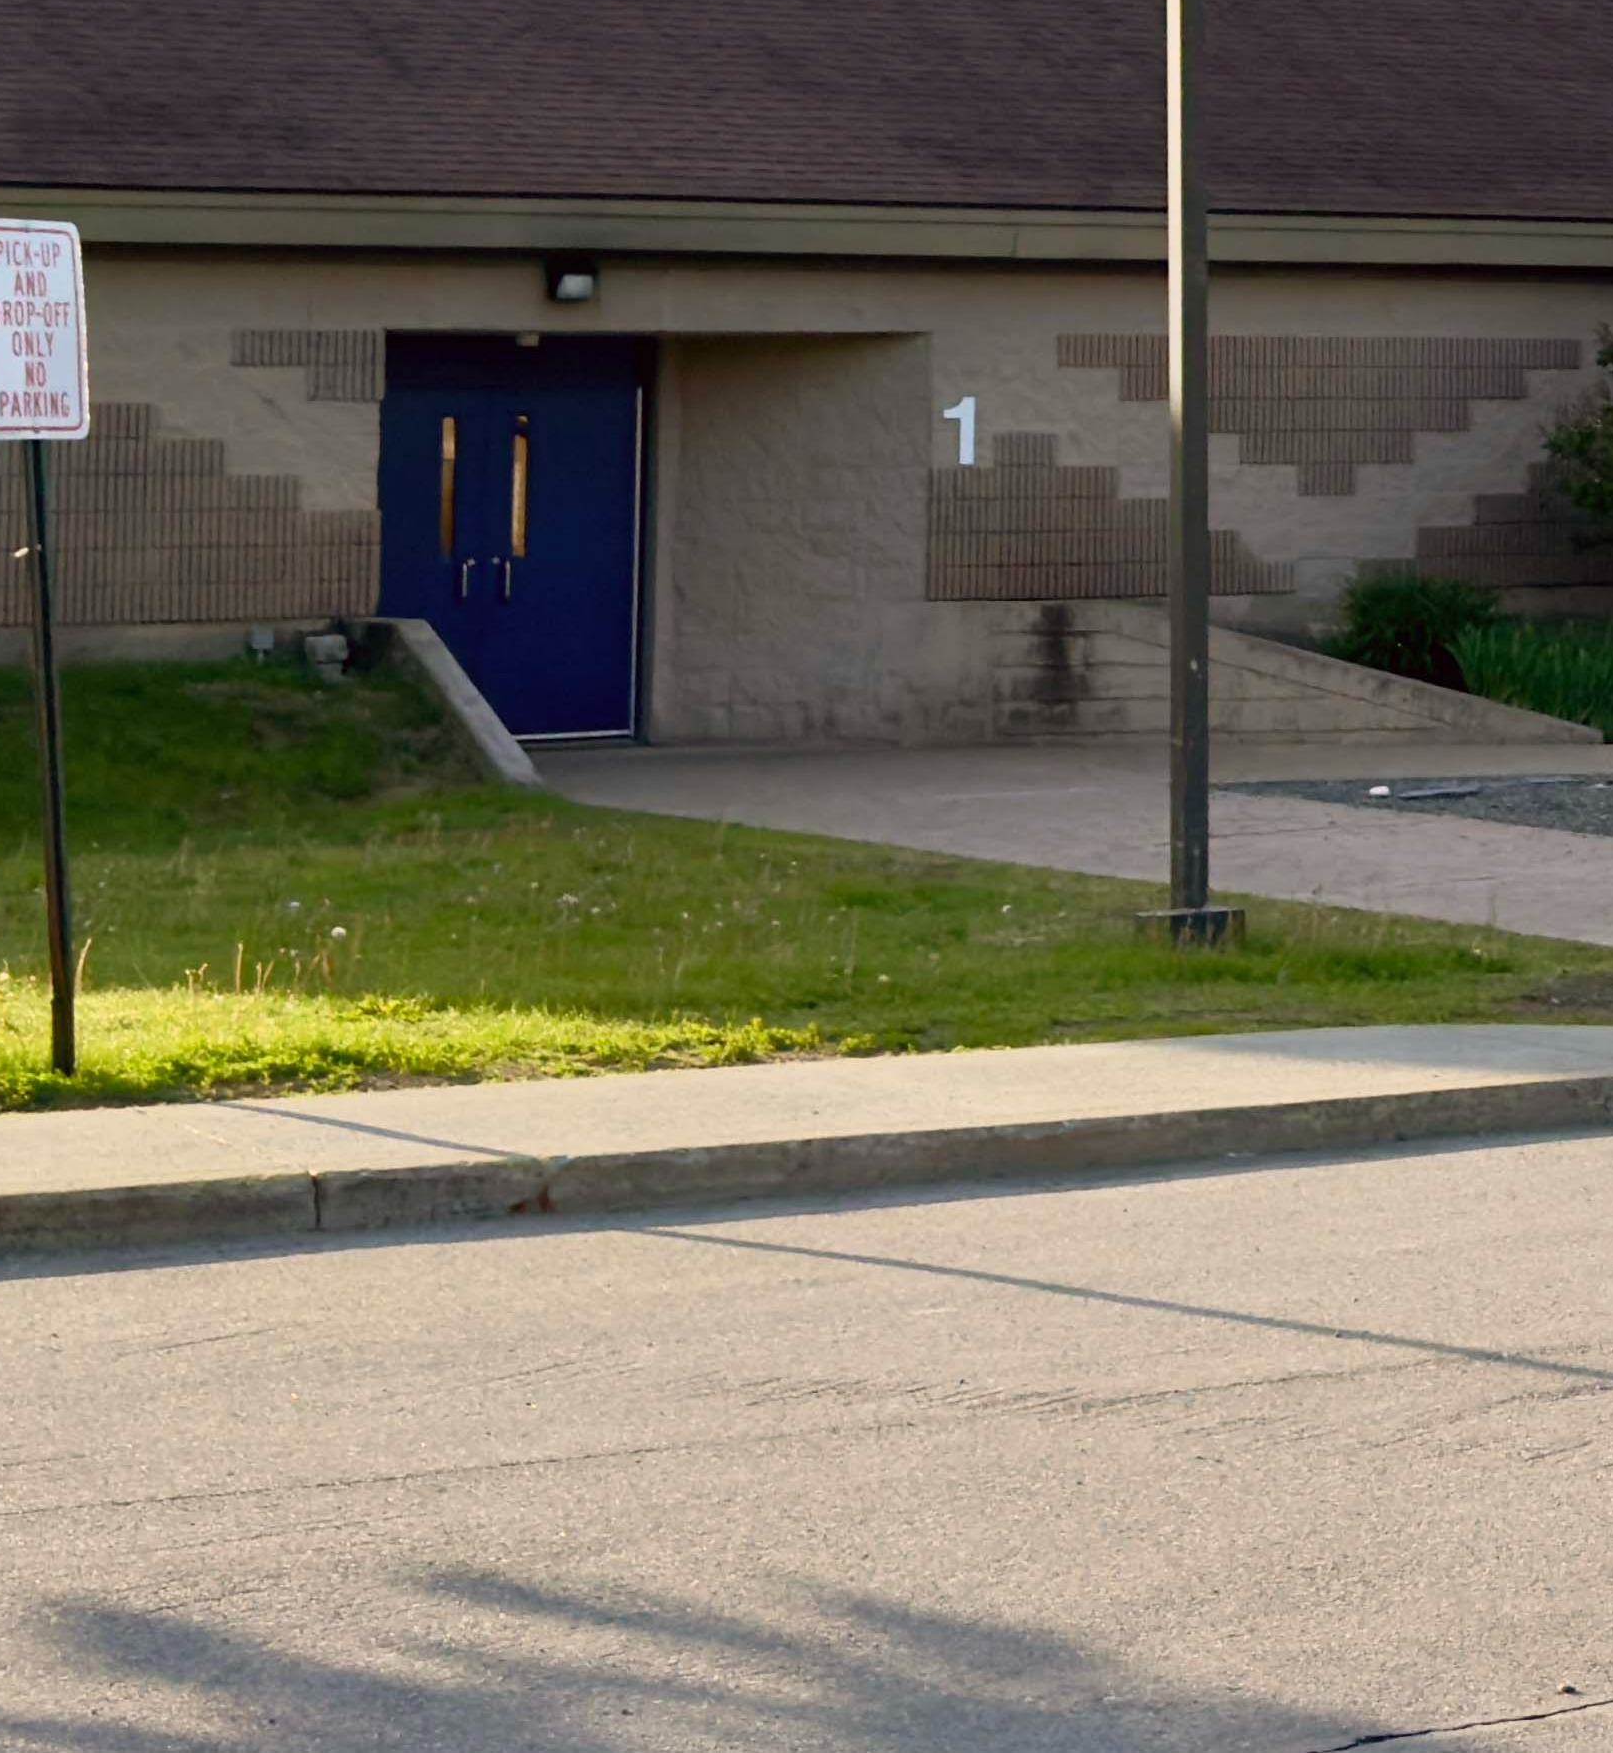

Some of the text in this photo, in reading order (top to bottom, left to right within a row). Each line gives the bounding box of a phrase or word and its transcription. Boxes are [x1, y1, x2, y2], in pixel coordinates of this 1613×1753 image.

[14, 271, 47, 297] AND
[12, 331, 55, 357] ONLY
[25, 362, 47, 387] NO
[0, 391, 71, 418] PARKING
[943, 396, 976, 465] 1
